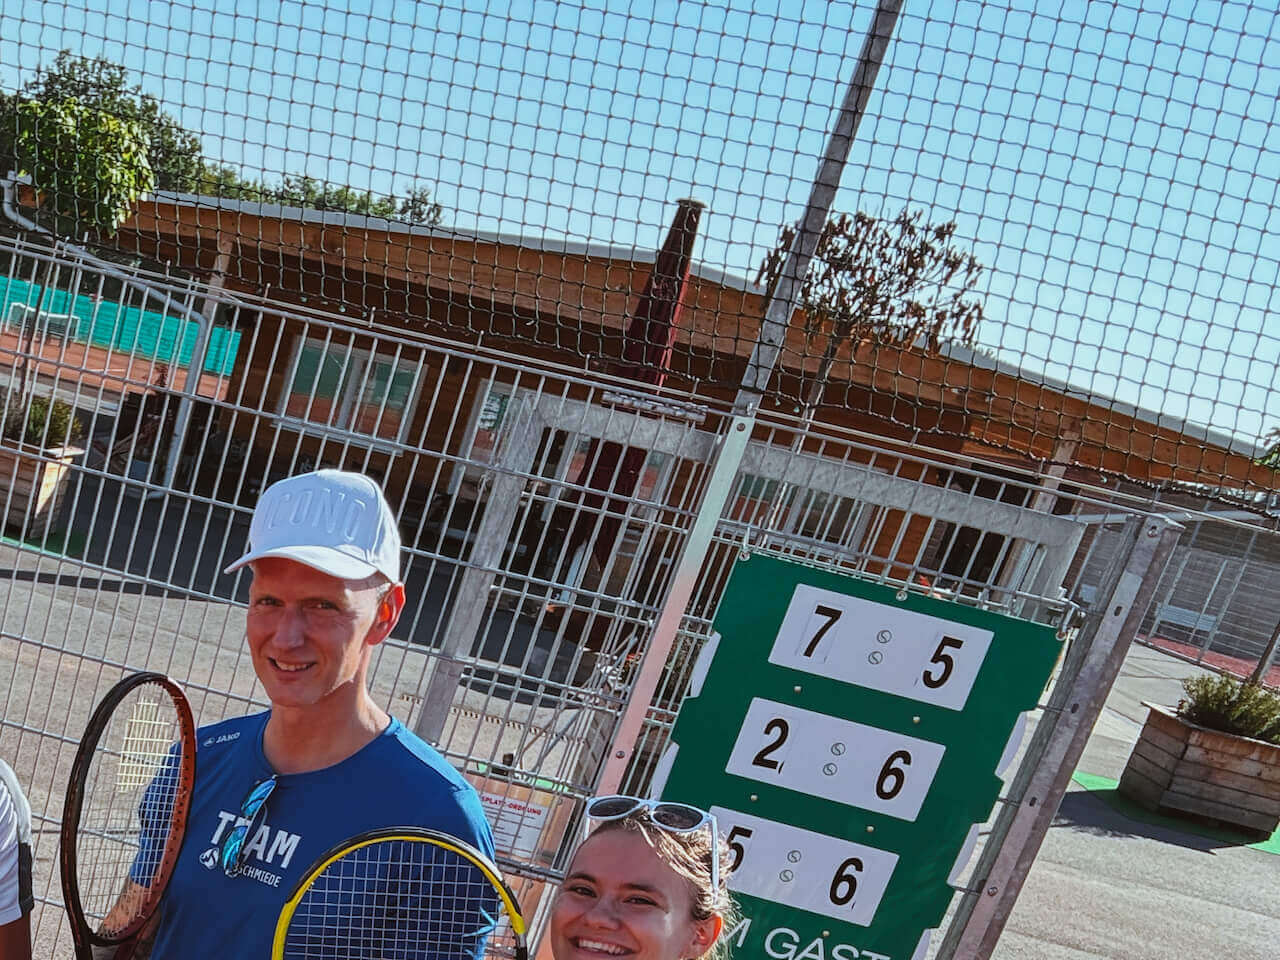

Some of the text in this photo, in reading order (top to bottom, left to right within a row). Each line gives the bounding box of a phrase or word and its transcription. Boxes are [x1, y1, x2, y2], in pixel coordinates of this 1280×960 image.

[803, 604, 964, 689] 7 5
[751, 718, 912, 801] 2 6
[829, 857, 864, 906] 6
